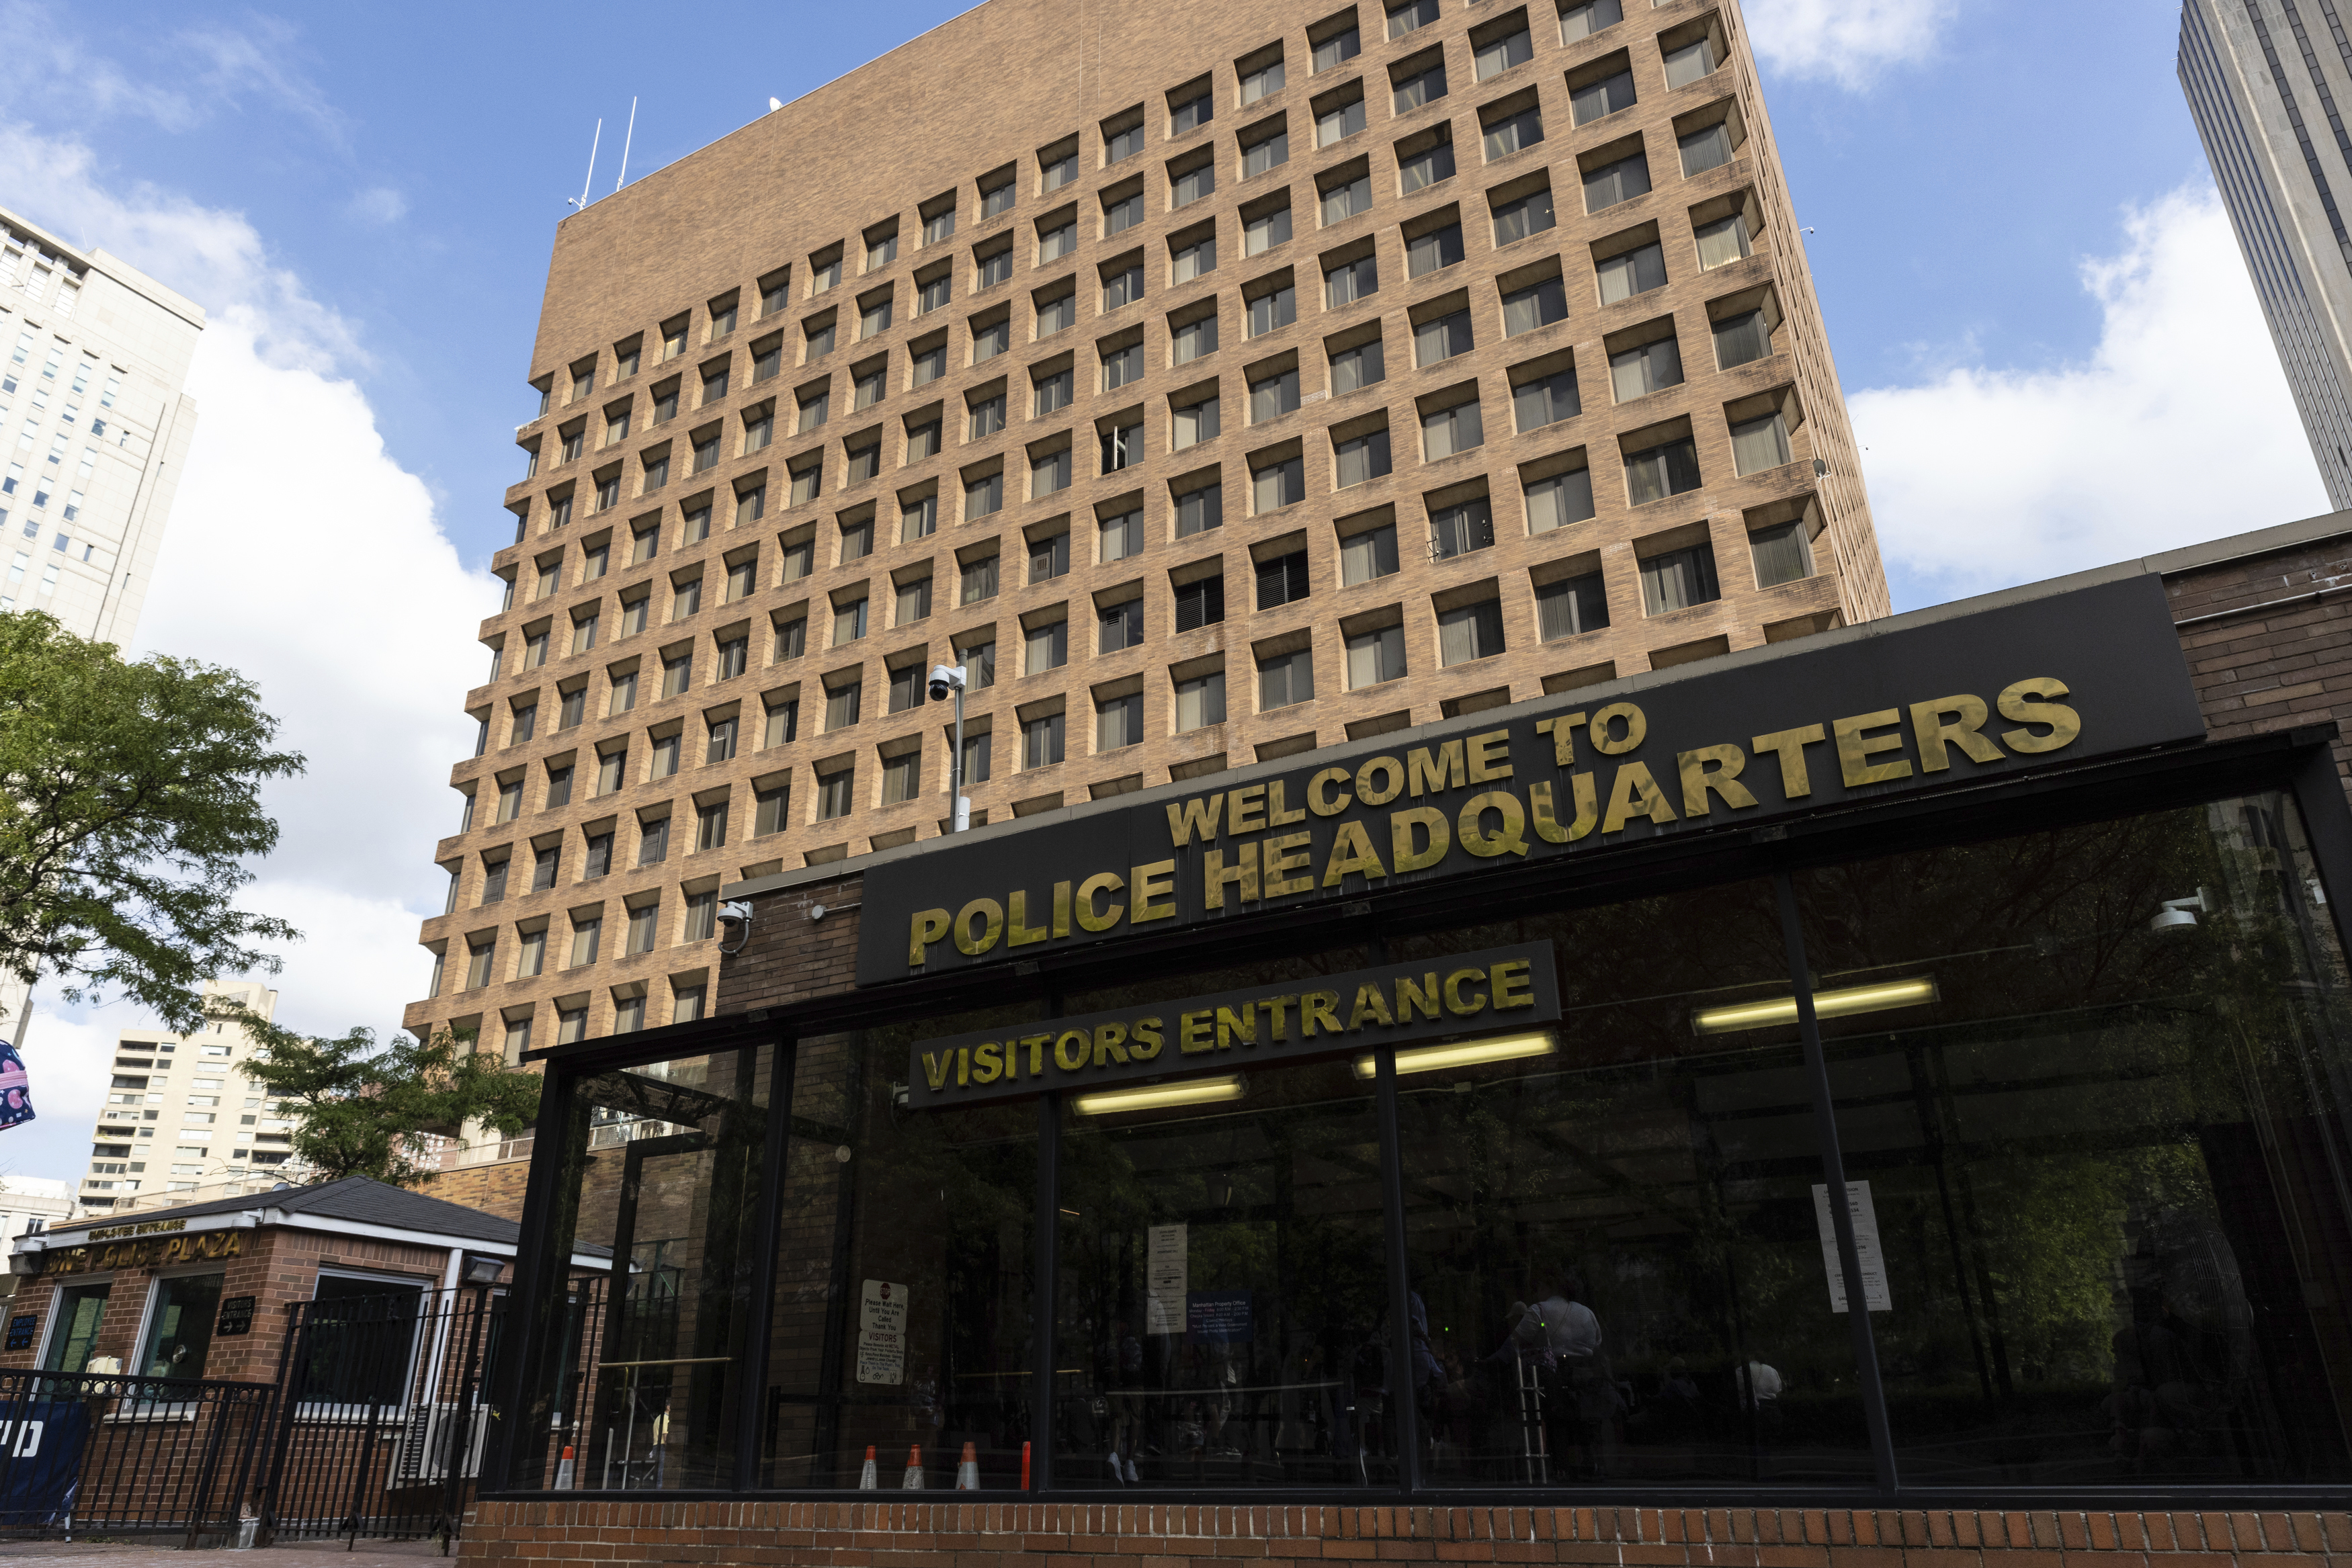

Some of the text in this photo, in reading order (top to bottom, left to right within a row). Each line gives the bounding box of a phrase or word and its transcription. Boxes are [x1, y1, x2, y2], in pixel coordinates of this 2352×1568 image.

[1166, 702, 1647, 847] WELCOME TO
[909, 677, 2081, 967] POLICE HEADQUARTERS
[921, 957, 1535, 1092] VISITORS ENTRANCE
[88, 1219, 187, 1242] EMPLOYEE ENTRANCE
[46, 1231, 241, 1274] ONE POLICE PLAZA
[880, 1287, 890, 1295] STOP
[227, 1299, 251, 1309] VISITORS
[865, 1298, 880, 1306] Please
[222, 1309, 252, 1320] ENTRANCE
[13, 1317, 36, 1327] EMPLOYEE
[10, 1327, 34, 1337] ENTRANCE
[869, 1332, 896, 1343] VISITORS
